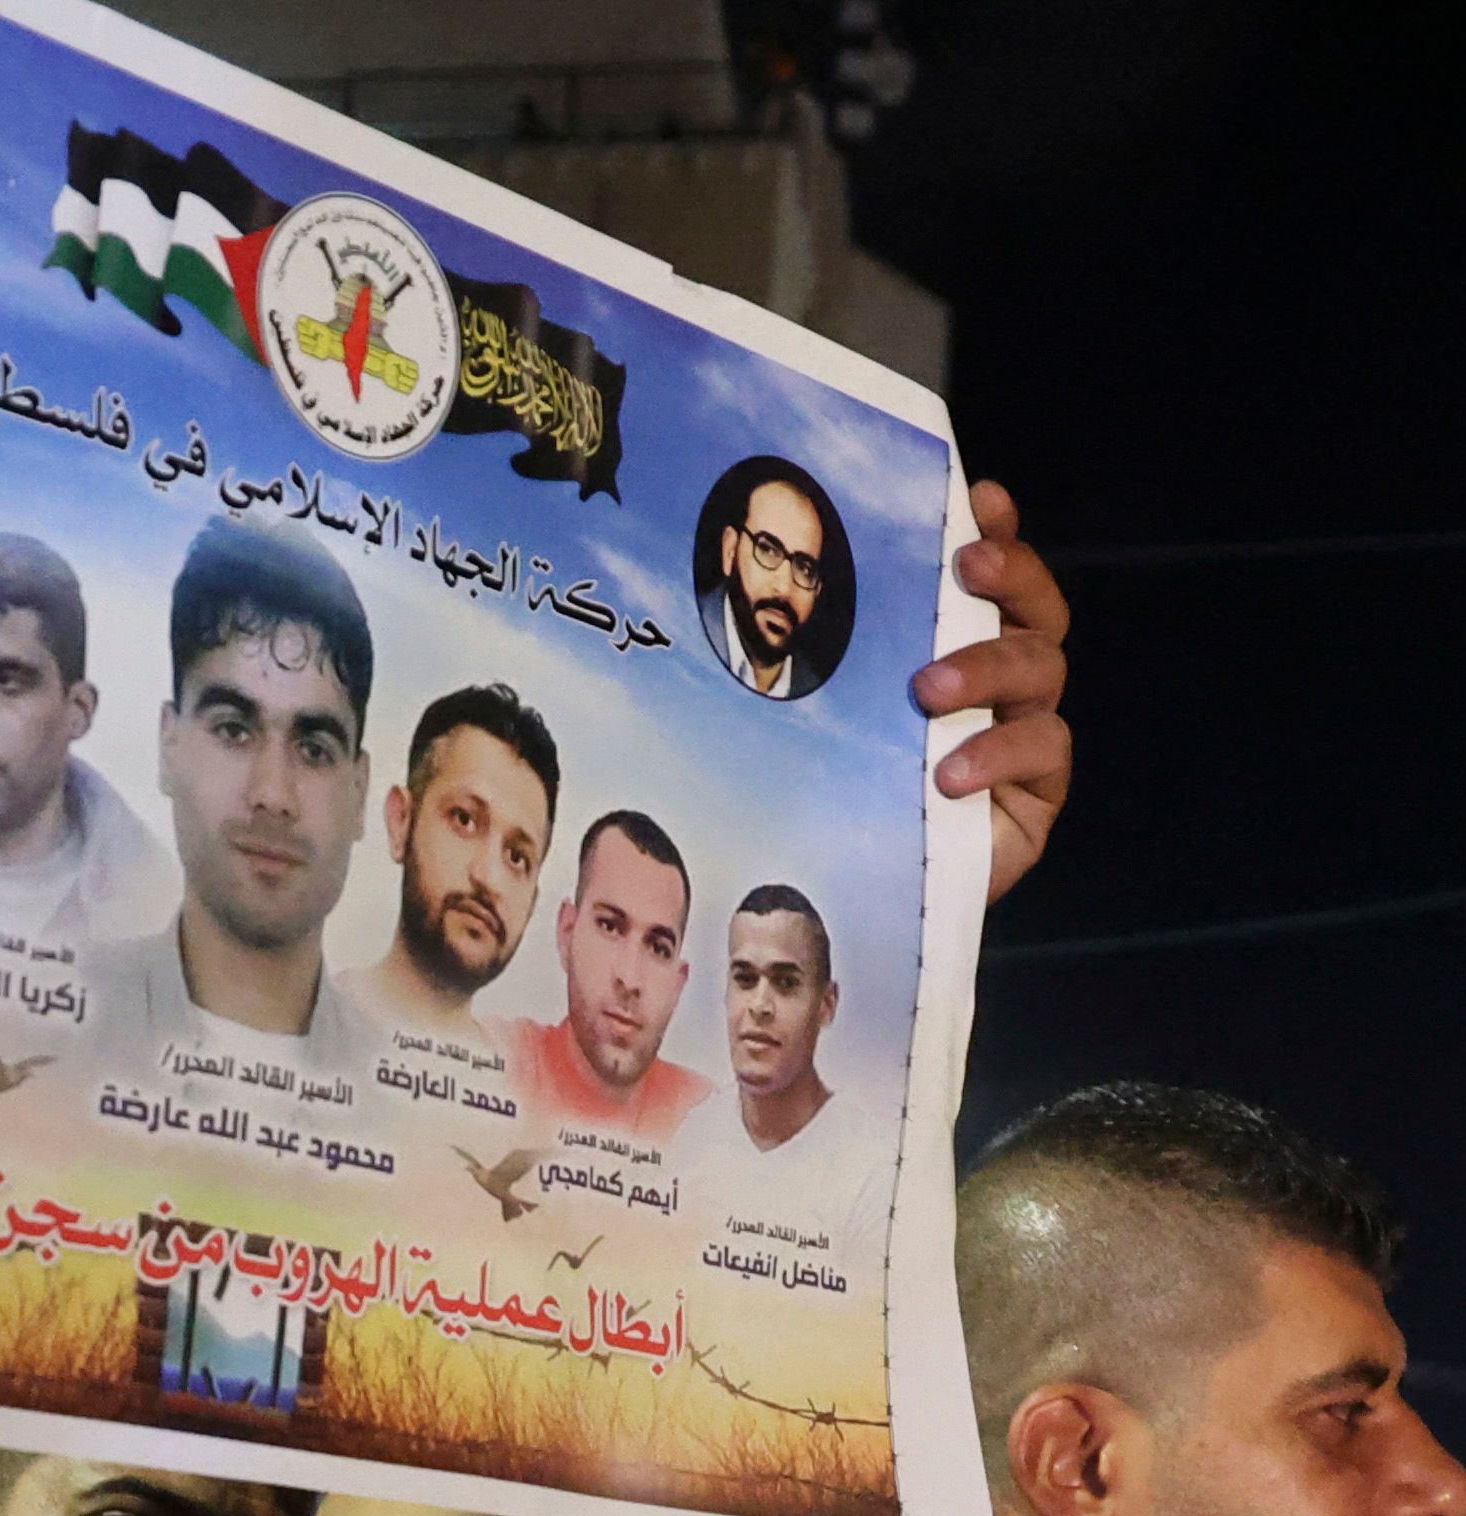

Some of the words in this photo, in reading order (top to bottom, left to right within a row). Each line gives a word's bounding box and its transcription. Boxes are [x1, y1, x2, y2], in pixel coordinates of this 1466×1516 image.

[145, 422, 207, 491] في
[220, 464, 399, 554] الإسلامي
[411, 518, 517, 597] الجهاد
[529, 557, 672, 652] حركة
[21, 976, 86, 1024] زكريا
[376, 1058, 455, 1100] العارضة
[462, 1088, 516, 1118] محمد
[99, 1083, 189, 1131] عارضة
[198, 1108, 248, 1141] الله
[256, 1124, 300, 1157] عبد
[307, 1133, 394, 1174] محمود
[539, 1164, 624, 1196] كمامجي
[628, 1177, 678, 1215] أيهم
[138, 1201, 224, 1279] من
[703, 1243, 777, 1279] انفيعات
[234, 1239, 398, 1314] الهروب
[404, 1246, 563, 1338] عملية
[782, 1260, 846, 1293] مناضل
[568, 1285, 686, 1376] أبطال
